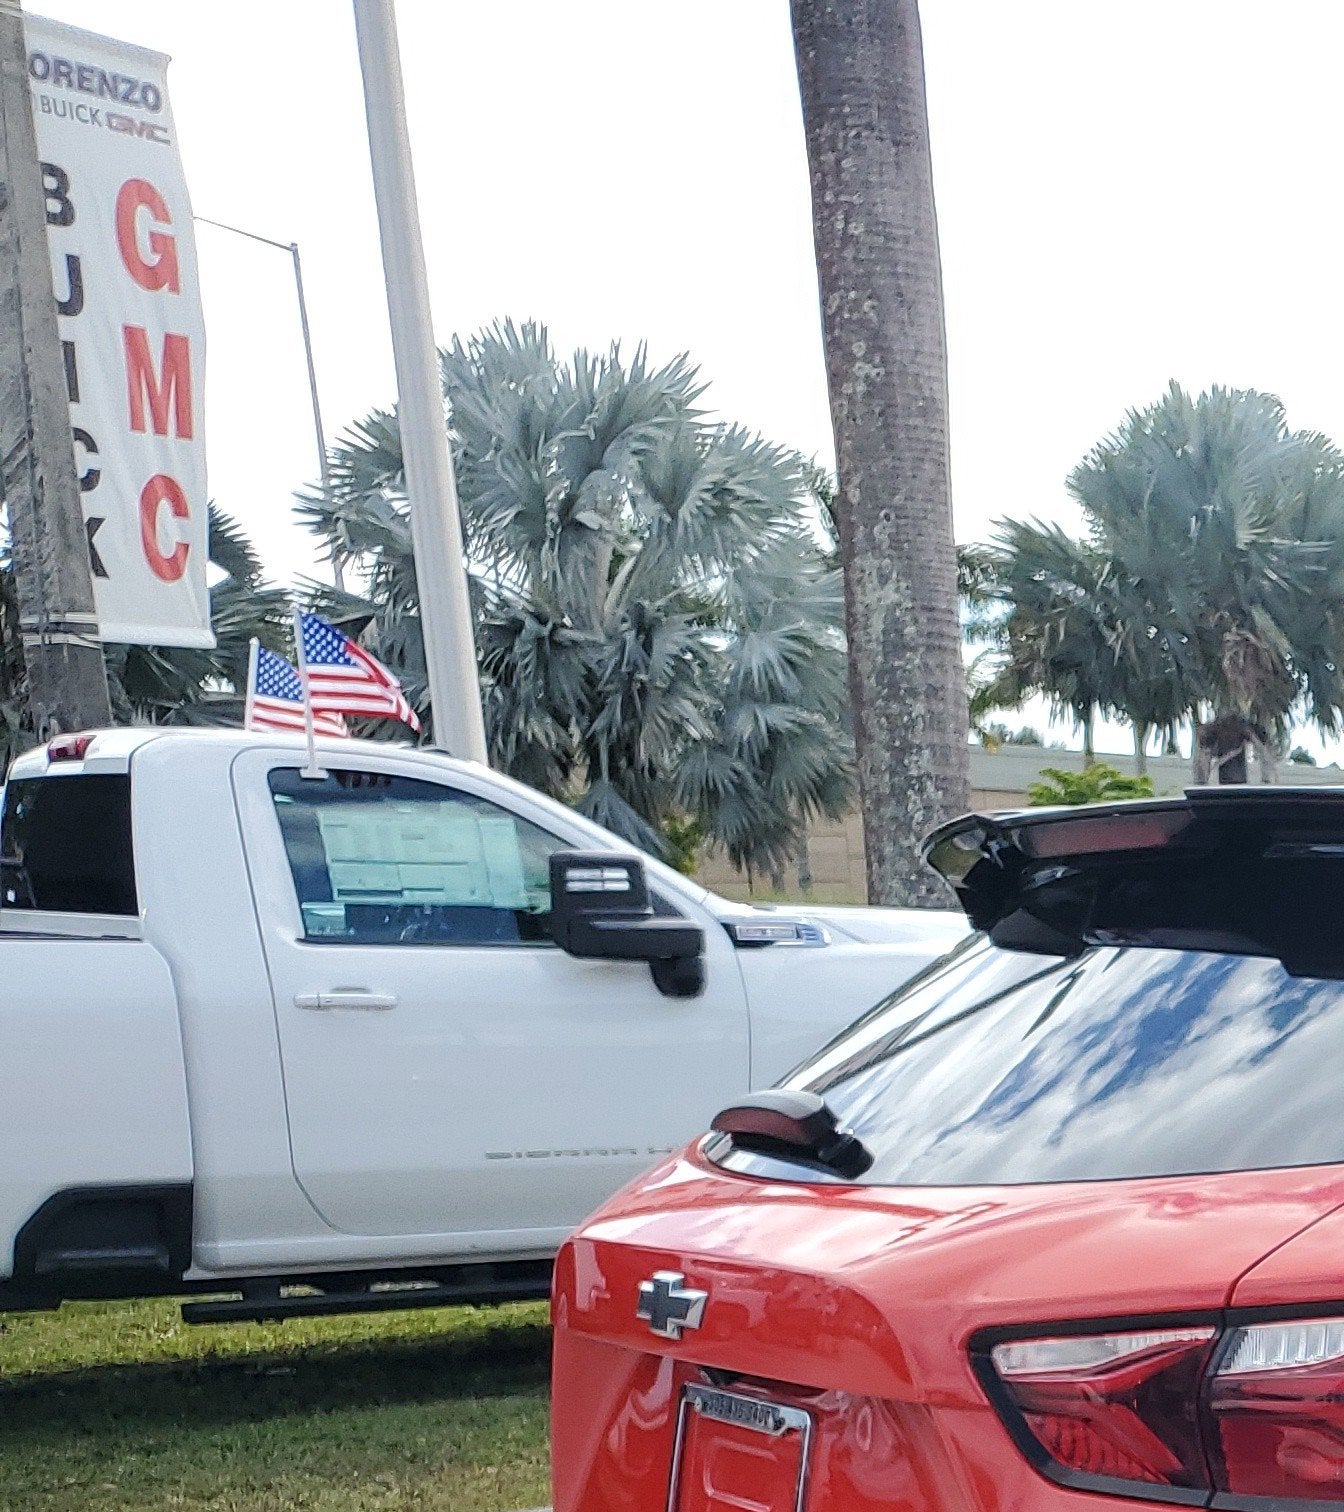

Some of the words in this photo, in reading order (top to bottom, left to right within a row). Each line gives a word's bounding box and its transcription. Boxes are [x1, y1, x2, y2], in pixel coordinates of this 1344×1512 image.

[29, 53, 161, 114] ORENZO
[40, 95, 101, 127] BUICK
[106, 112, 170, 146] GMC
[115, 178, 193, 584] GMC
